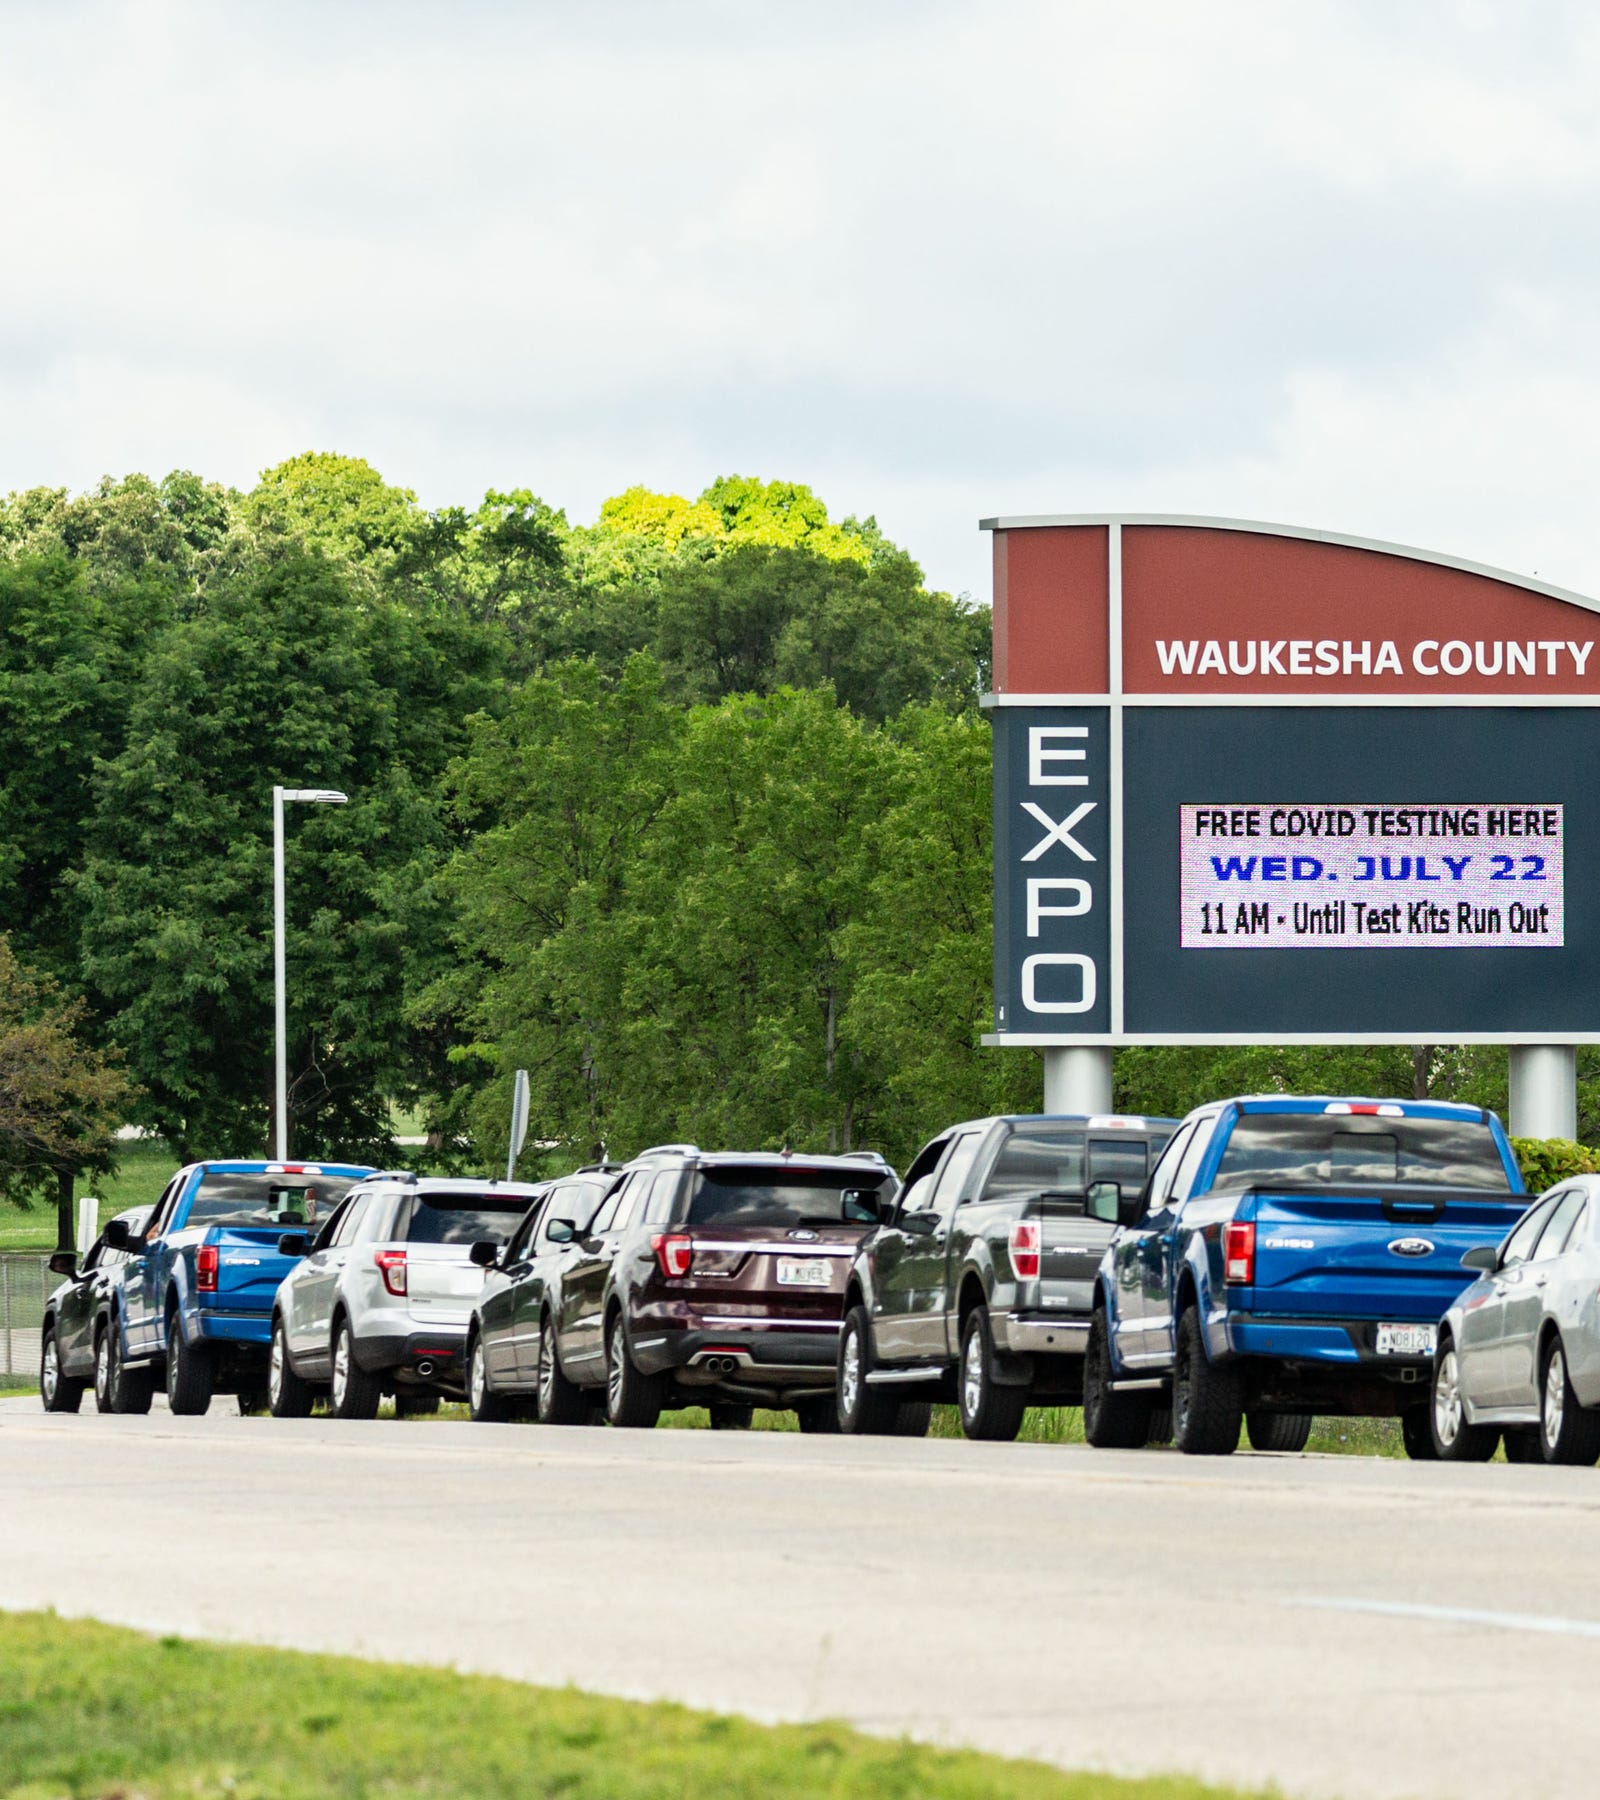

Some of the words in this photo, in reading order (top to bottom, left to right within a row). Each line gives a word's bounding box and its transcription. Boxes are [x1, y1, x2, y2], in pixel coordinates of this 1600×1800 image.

[1156, 640, 1403, 675] WAUKESHA
[1413, 640, 1594, 675] COUNTY
[1195, 809, 1260, 837] FREE
[1269, 809, 1356, 837] COVID
[1363, 809, 1480, 837] TESTING
[1486, 809, 1558, 837] HERE
[1020, 727, 1097, 1013] EXPO
[1210, 854, 1338, 881] WED.
[1354, 854, 1472, 881] JULY
[1490, 854, 1547, 881] 22
[1201, 903, 1228, 934] 11
[1234, 903, 1270, 934] AM
[1293, 901, 1346, 935] Until
[1351, 903, 1402, 935] Test
[1408, 901, 1450, 935] Kits
[1457, 903, 1501, 935] Run
[1508, 903, 1550, 935] Out
